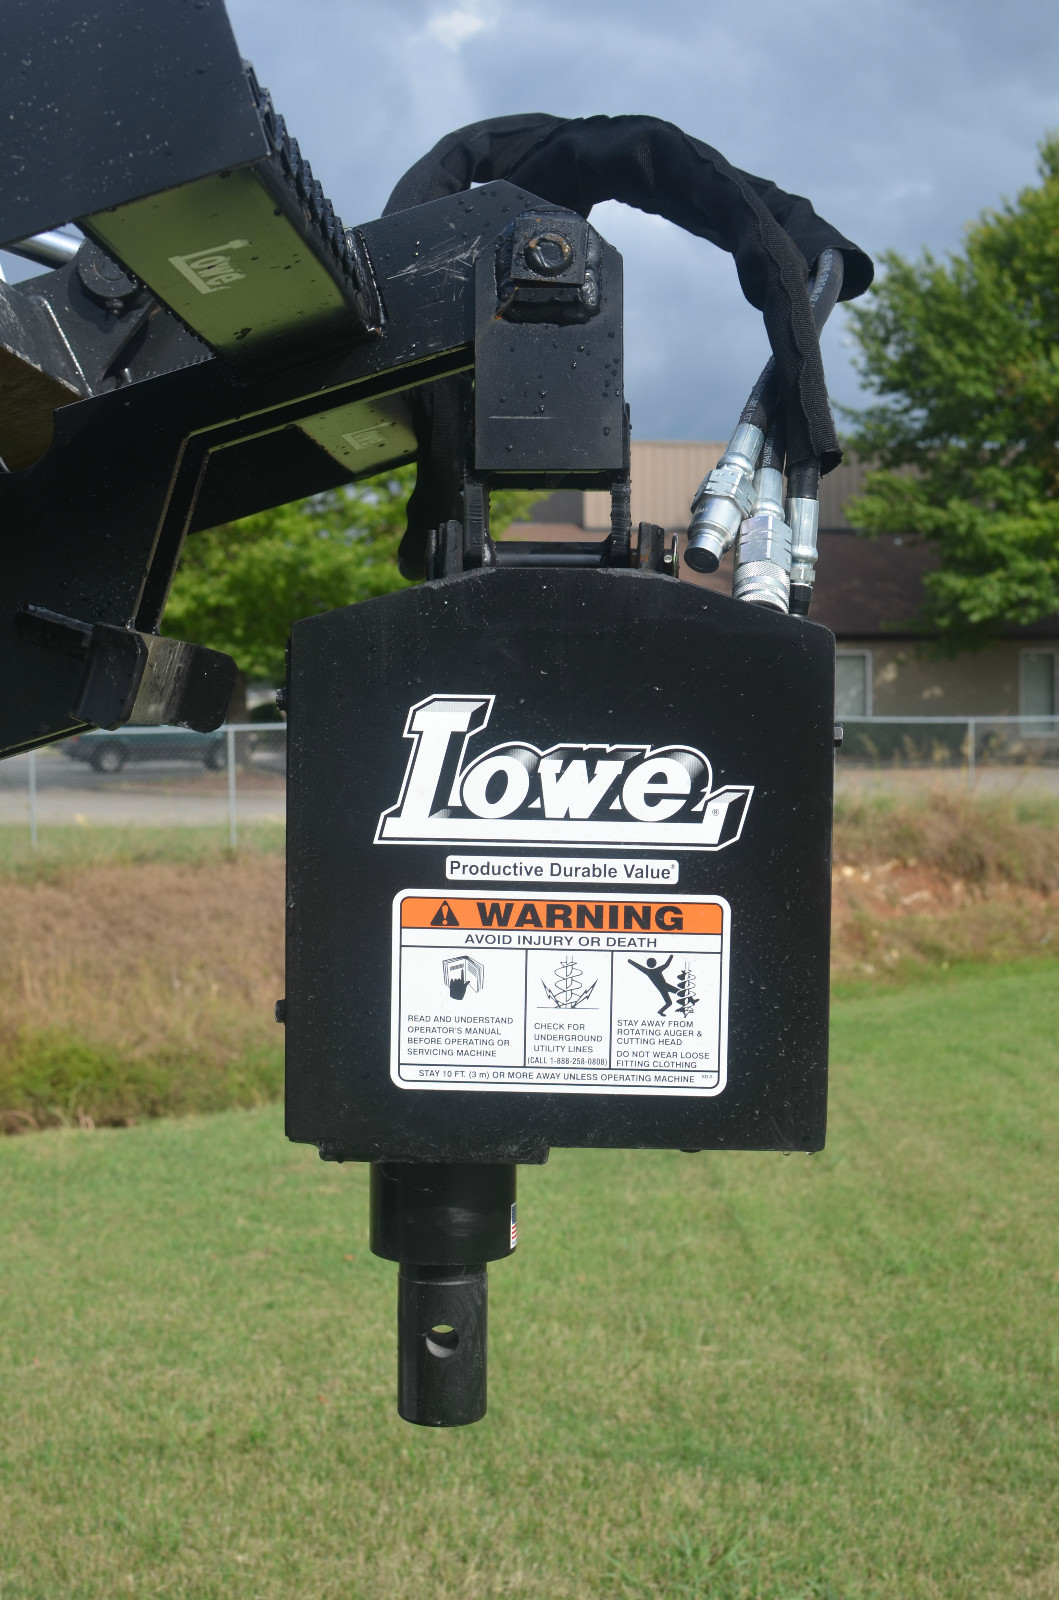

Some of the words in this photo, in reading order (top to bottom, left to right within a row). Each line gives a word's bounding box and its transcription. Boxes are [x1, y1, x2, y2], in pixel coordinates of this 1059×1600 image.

[450, 860, 544, 877] Productive
[550, 863, 618, 879] Durable
[477, 902, 683, 931] WARNING
[465, 933, 512, 946] AVOID
[517, 935, 572, 947] INJURY
[578, 936, 602, 947] OR
[606, 936, 657, 948] DEATH
[455, 1016, 513, 1024] UNDERSTAND
[408, 1026, 462, 1034] OPERATOR'S
[445, 1038, 495, 1046] OPERATING
[497, 1039, 510, 1047] OR
[534, 1034, 603, 1042] UNDERGROUND
[408, 1048, 454, 1056] SERVICING
[617, 1060, 650, 1068] FITTING
[653, 1061, 697, 1069] CLOTHING
[469, 1071, 477, 1079] (3
[480, 1071, 490, 1080] m)
[492, 1071, 505, 1079] OR
[564, 1073, 598, 1081] UNLESS
[601, 1074, 653, 1082] OPERATING
[654, 1075, 695, 1083] MACHINE
